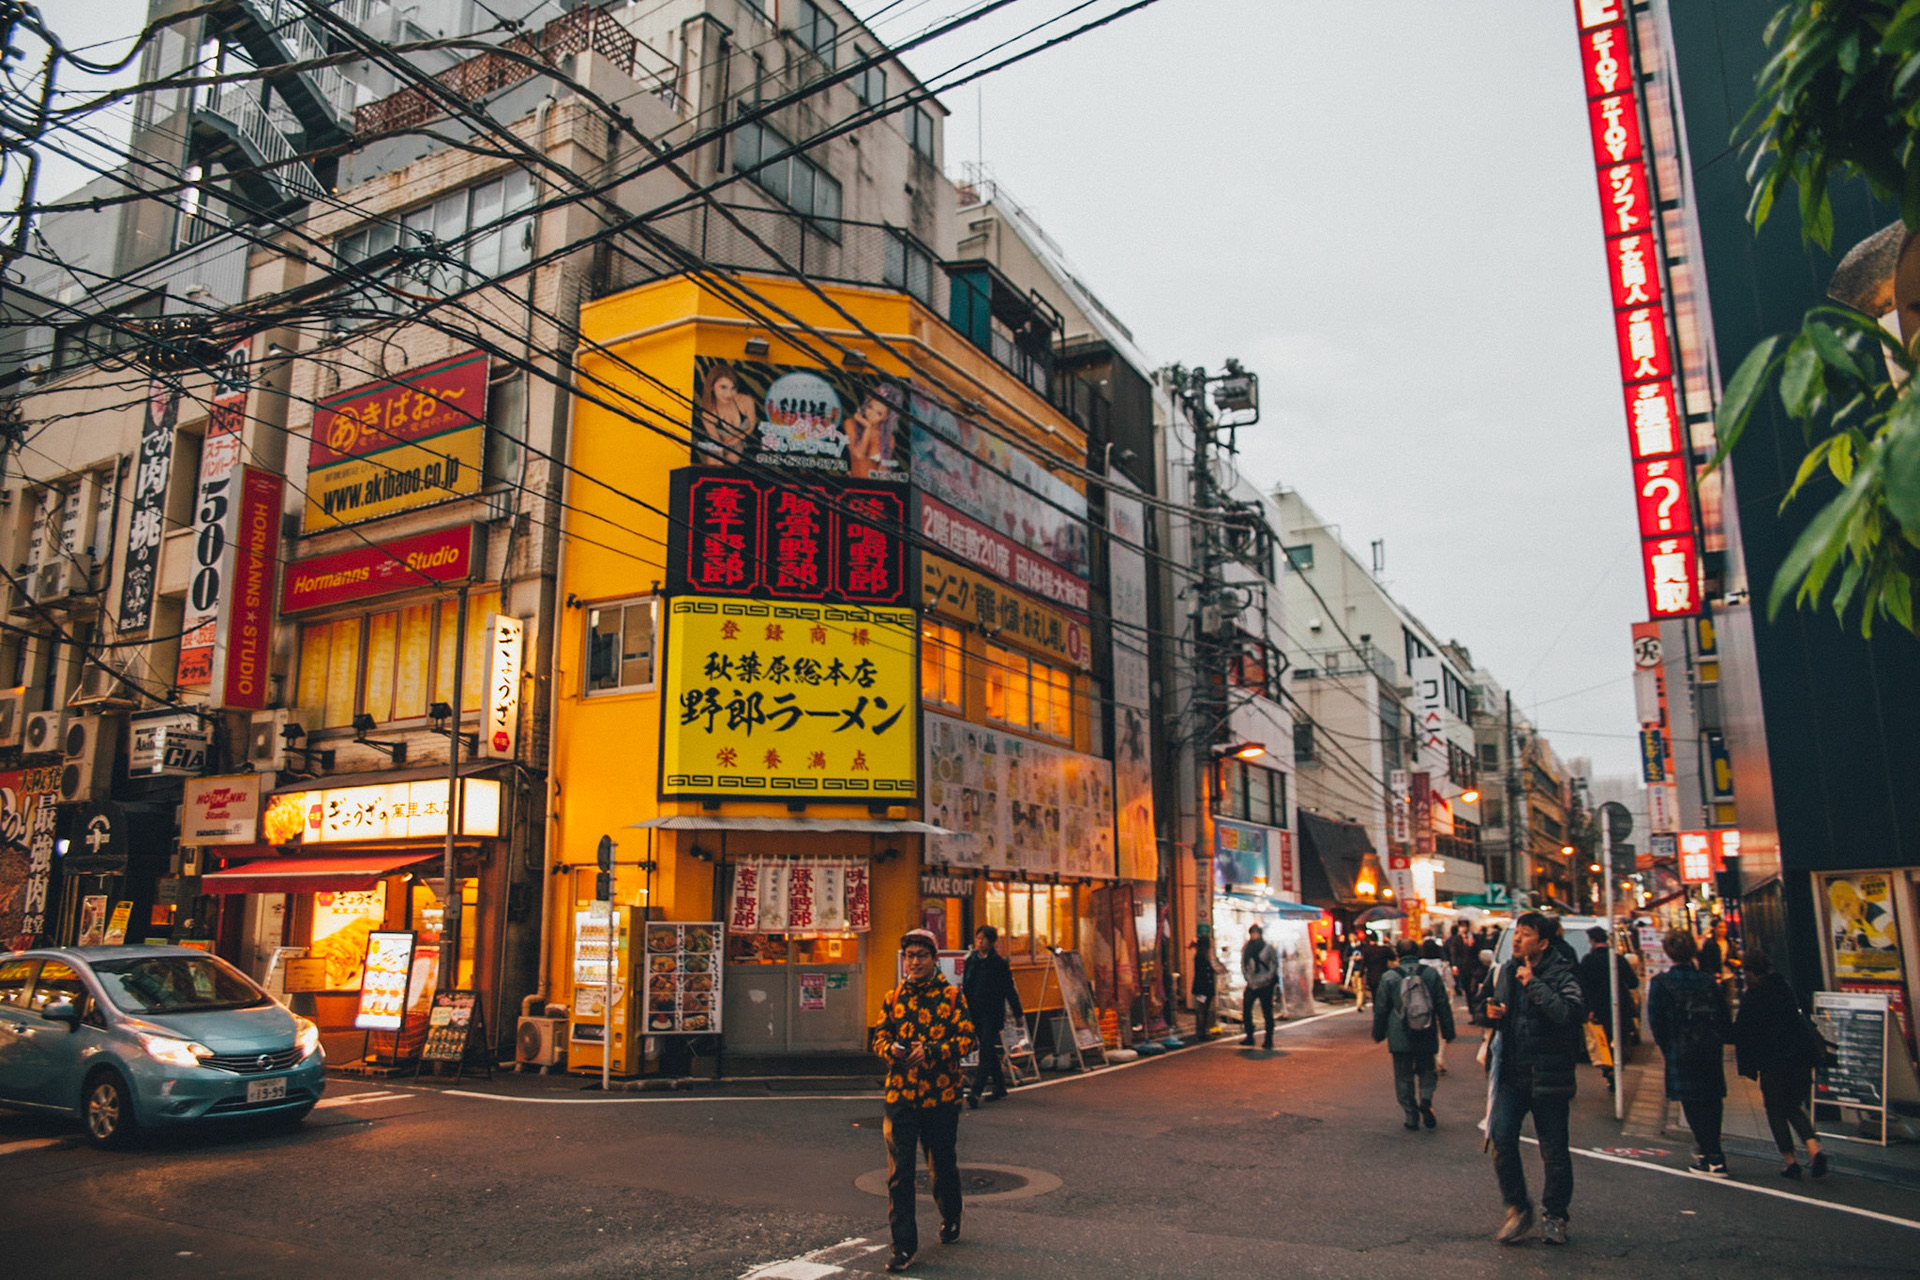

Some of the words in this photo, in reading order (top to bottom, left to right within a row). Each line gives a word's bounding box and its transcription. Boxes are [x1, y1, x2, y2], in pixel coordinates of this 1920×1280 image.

[1593, 42, 1617, 92] TOY
[1602, 108, 1627, 161] TOY
[1612, 177, 1638, 232] ソフト
[323, 454, 459, 515] www.akibaoo.co.jp
[245, 502, 268, 609] HORMANNS
[702, 486, 745, 585] 煮干野郎
[776, 491, 820, 589] 豚骨野郎
[294, 565, 370, 595] Hormanns
[404, 545, 459, 572] Studio
[720, 619, 870, 646] 登録商標
[238, 625, 257, 696] STUDIO
[495, 626, 520, 726] ぎょうざ
[704, 651, 878, 688] 秋葉原総本店
[680, 686, 906, 737] 野郎ラーメン
[716, 747, 870, 771] 栄養満点
[789, 868, 814, 927] 豚骨野郎
[921, 876, 950, 895] TAKE
[952, 877, 974, 896] OUT
[1486, 883, 1508, 904] 12
